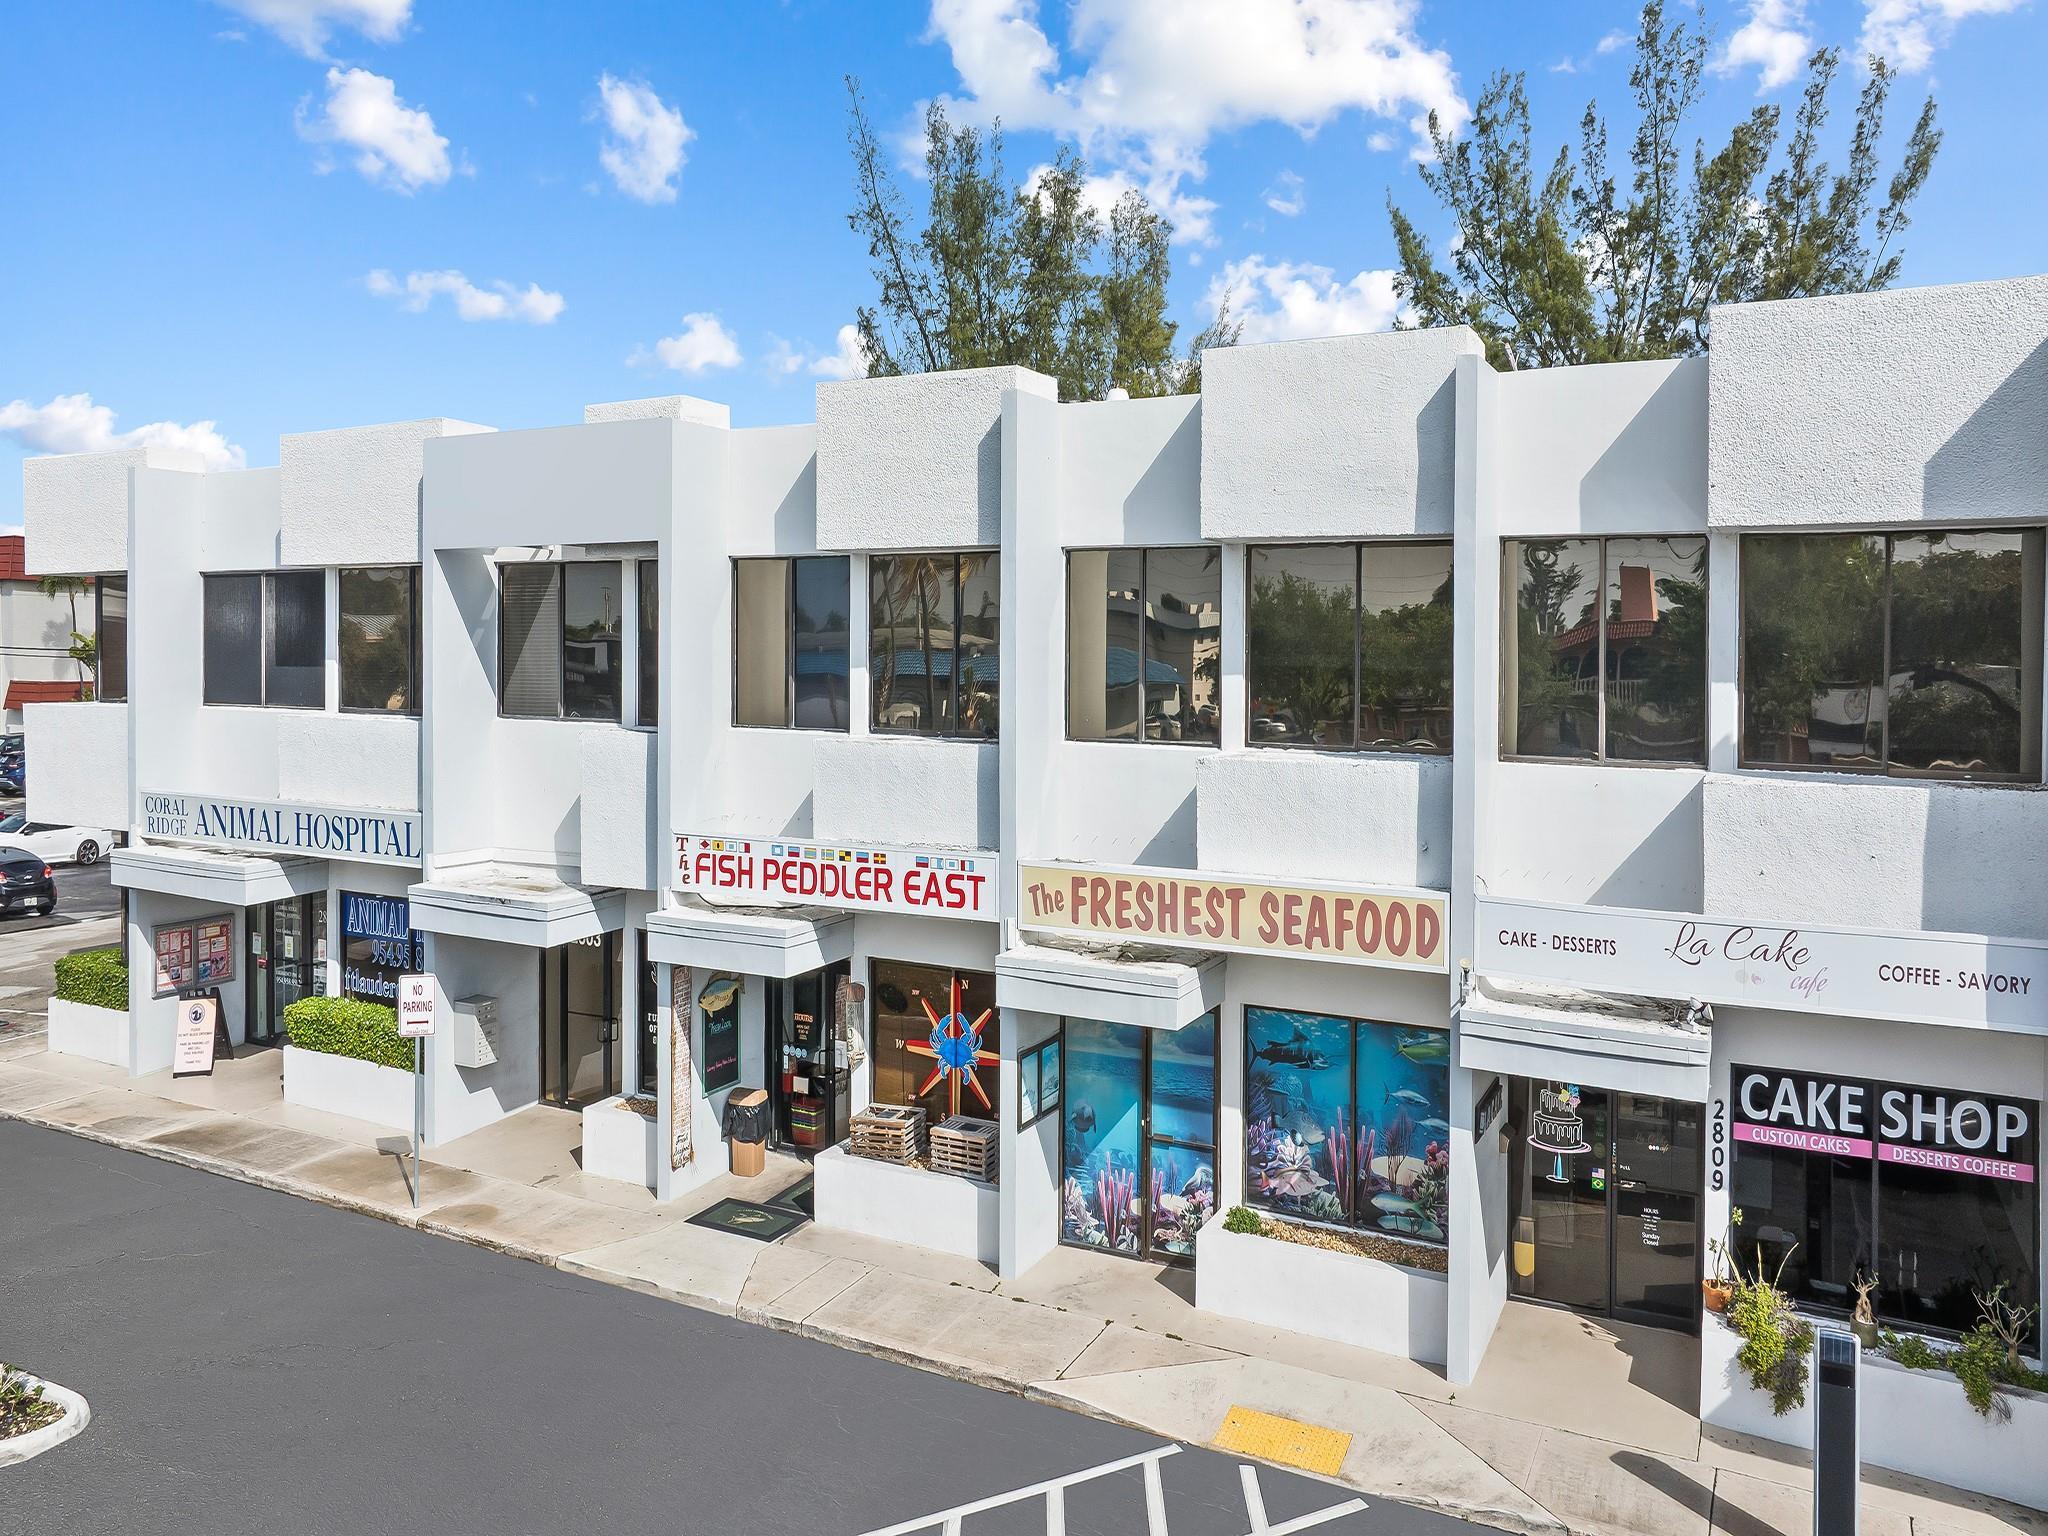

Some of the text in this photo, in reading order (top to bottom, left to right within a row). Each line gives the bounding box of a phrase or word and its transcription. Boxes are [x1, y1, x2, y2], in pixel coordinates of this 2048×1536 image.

[145, 796, 188, 816] CORAL
[148, 816, 187, 836] RIDGE
[194, 804, 421, 858] ANIMAL HOSPITAL
[676, 837, 690, 884] The
[695, 853, 986, 911] FISH PEDDLER EAST
[347, 897, 409, 940] ANIMAL
[1027, 876, 1440, 959] The FRESHEST SEAFOOD
[1498, 929, 1537, 949] CAKE
[1552, 934, 1617, 956] DESSERTS
[1664, 922, 1811, 972] La Cake
[412, 984, 424, 996] NO
[961, 980, 969, 990] N
[1879, 964, 1940, 986] COFFEE
[1958, 971, 2031, 994] SAVORY
[403, 1000, 433, 1013] PARKING
[895, 1038, 905, 1049] W
[1740, 1074, 2028, 1153] CAKE SHOP
[1711, 1100, 1725, 1191] 2809
[1752, 1127, 1850, 1154] CUSTOM CAKES
[1893, 1147, 2017, 1178] DESSERTS COFFEE
[1643, 1207, 1659, 1215] HOURS
[1642, 1231, 1660, 1241] Sunday
[1643, 1239, 1659, 1247] Closed
